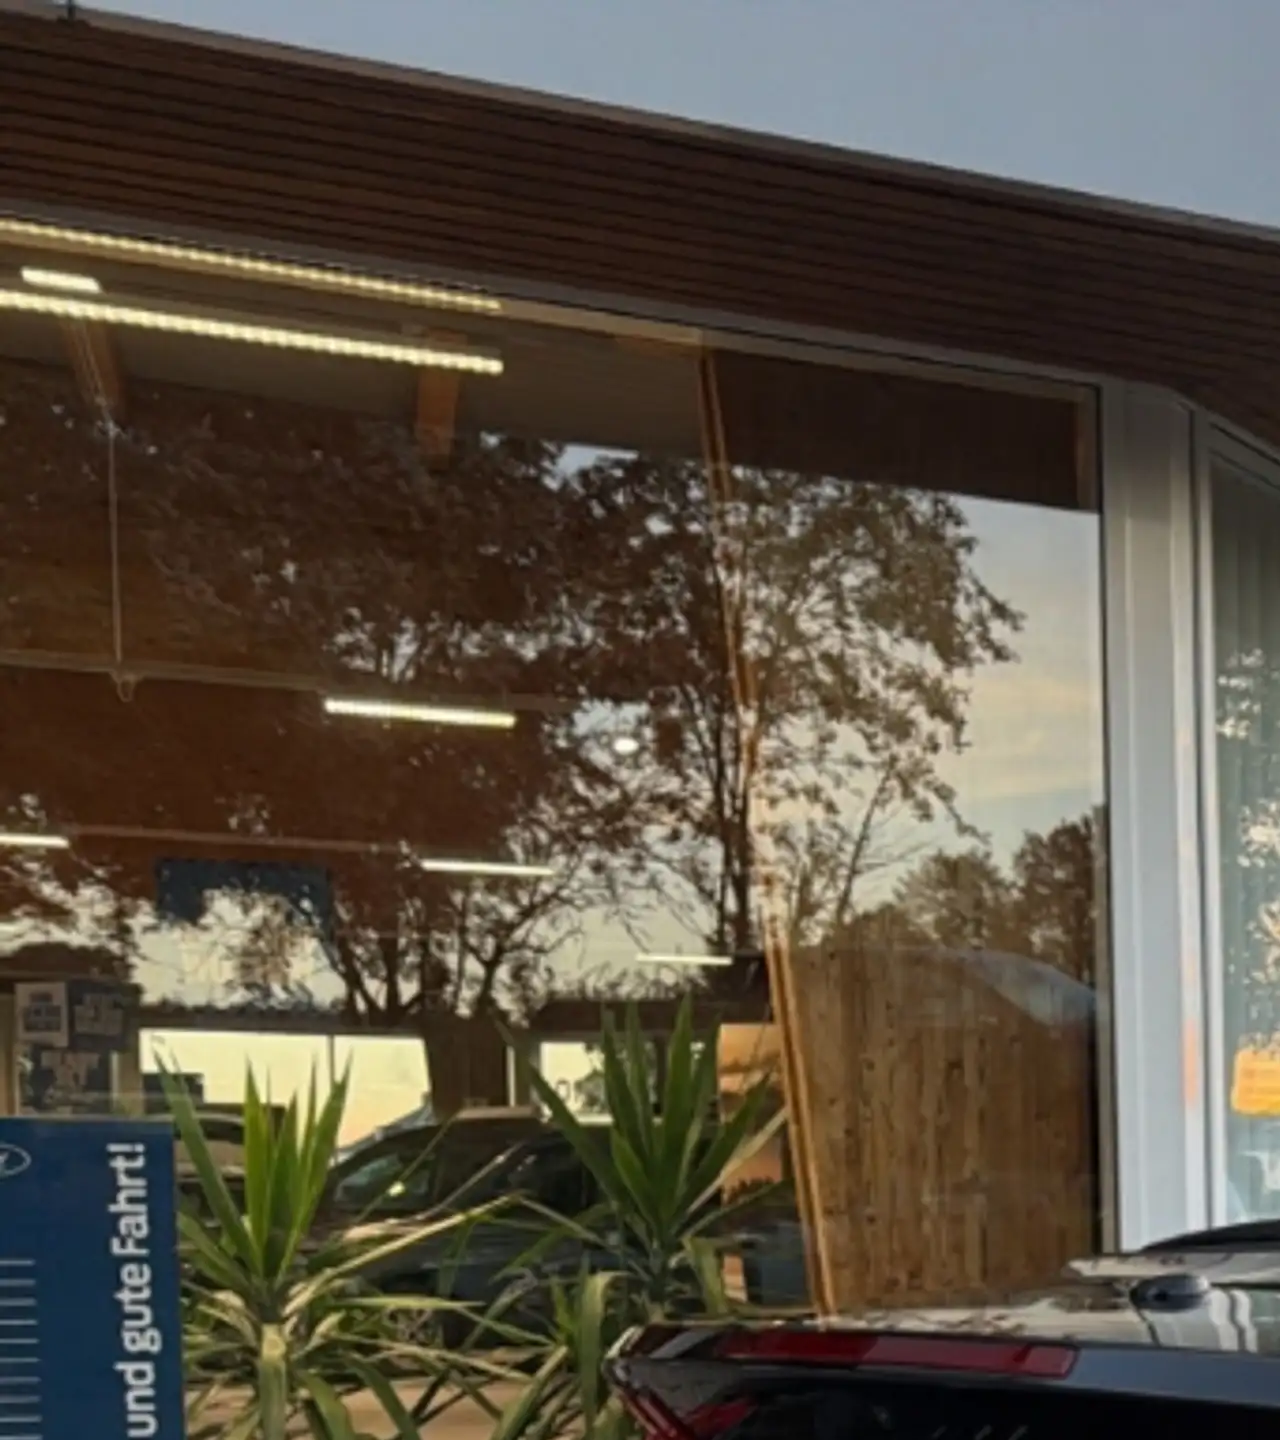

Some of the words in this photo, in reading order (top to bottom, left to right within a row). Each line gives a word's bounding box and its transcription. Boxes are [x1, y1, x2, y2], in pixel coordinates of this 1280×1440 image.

[106, 1143, 151, 1255] Fahrt!
[113, 1262, 162, 1355] gute
[113, 1362, 159, 1438] und
